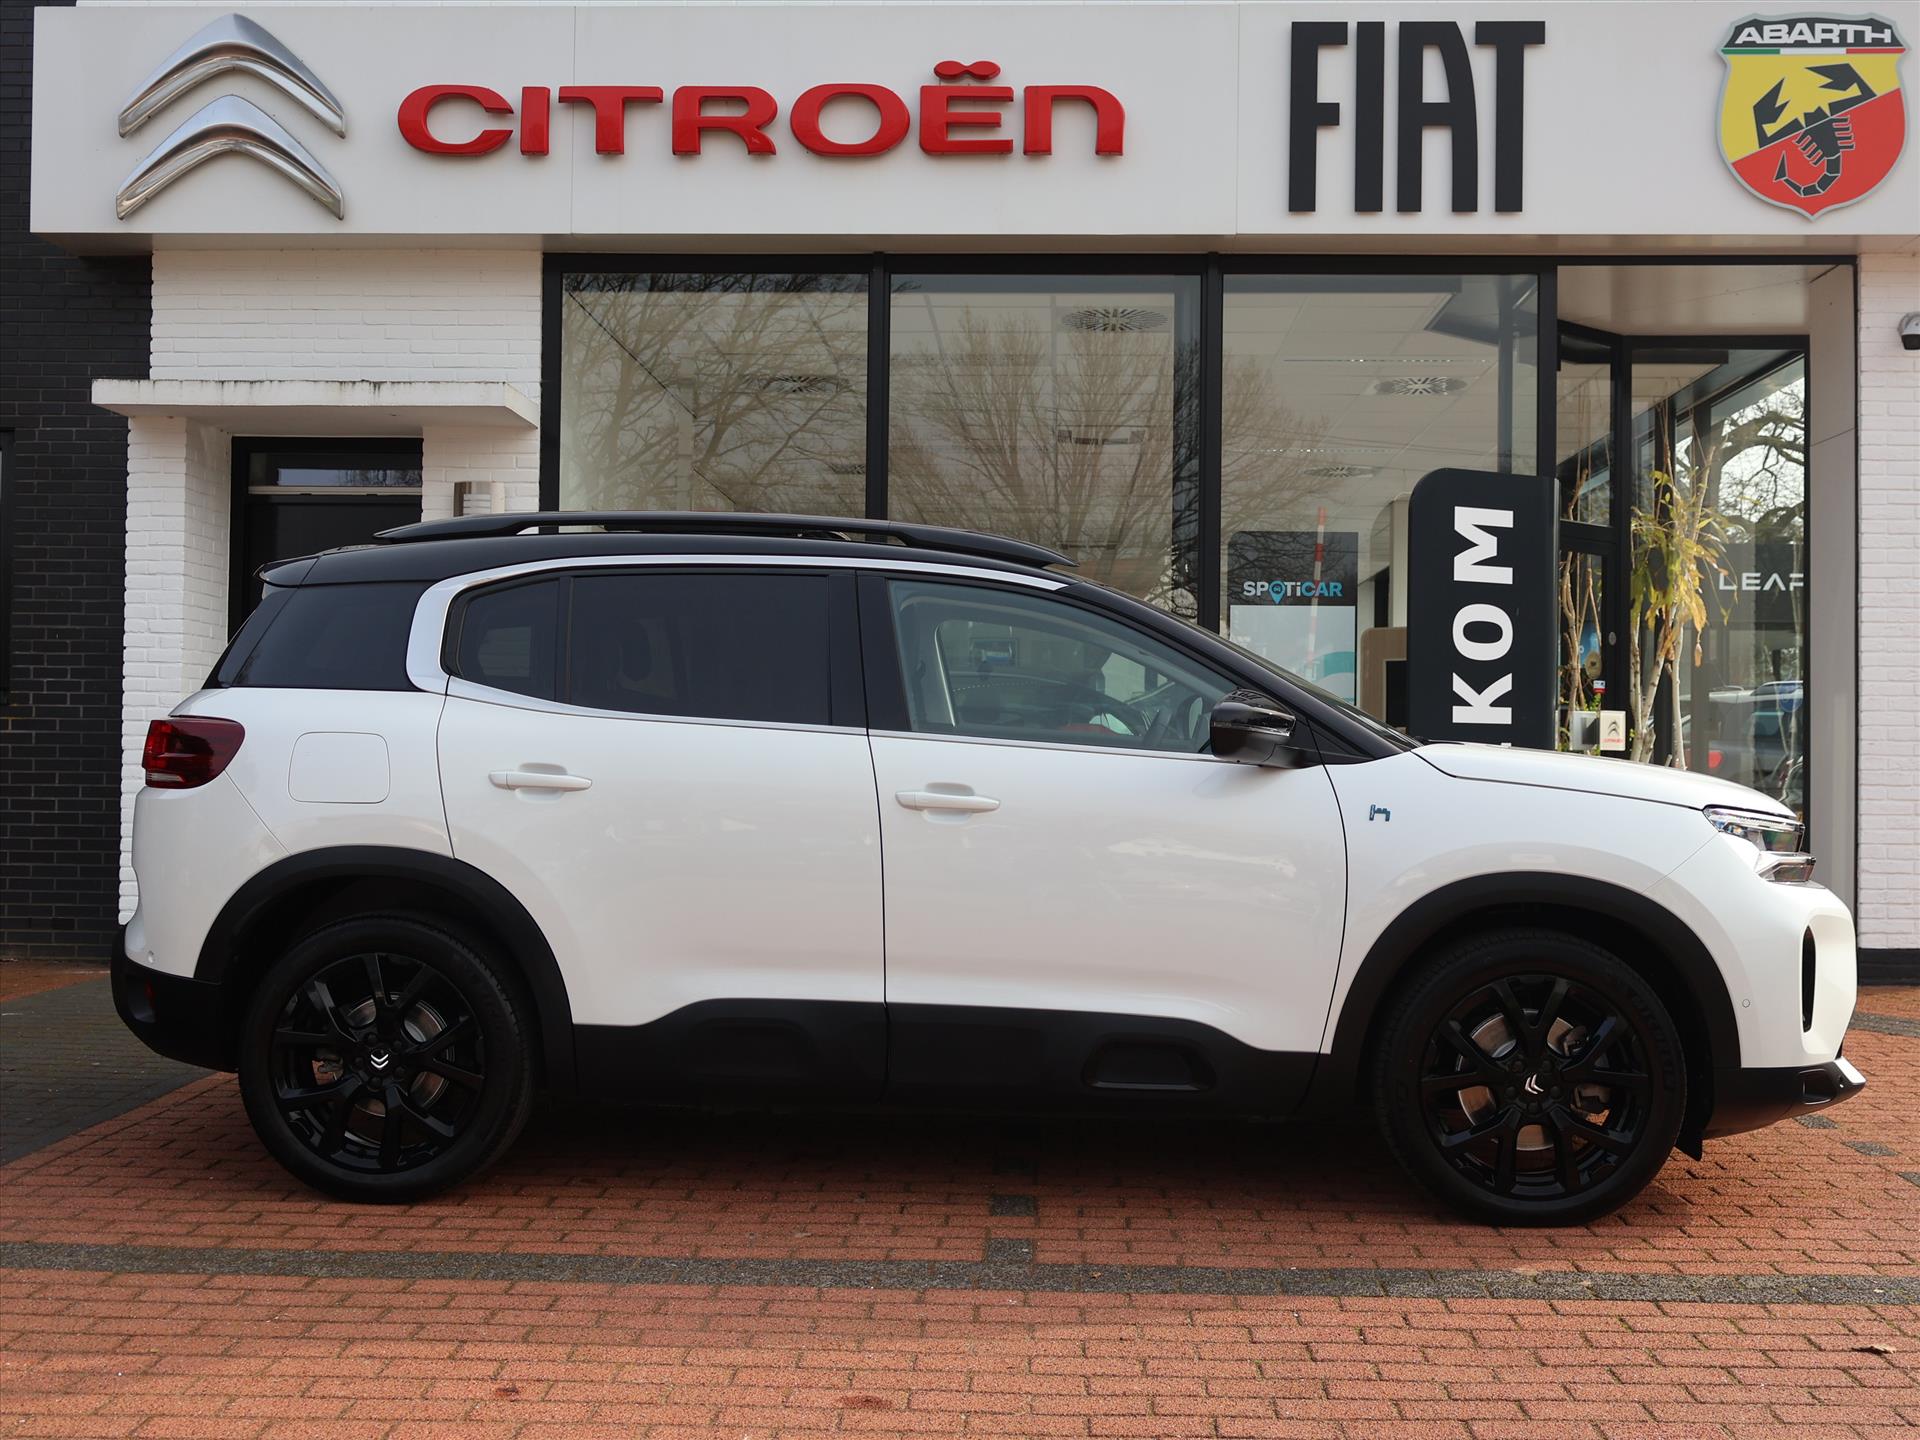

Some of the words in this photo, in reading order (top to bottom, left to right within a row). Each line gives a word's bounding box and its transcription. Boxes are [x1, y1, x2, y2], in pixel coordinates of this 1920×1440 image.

[1735, 22, 1892, 44] ABARTH
[397, 60, 1126, 157] CITROËN
[1289, 21, 1546, 213] FIAT
[1453, 506, 1514, 748] KOM
